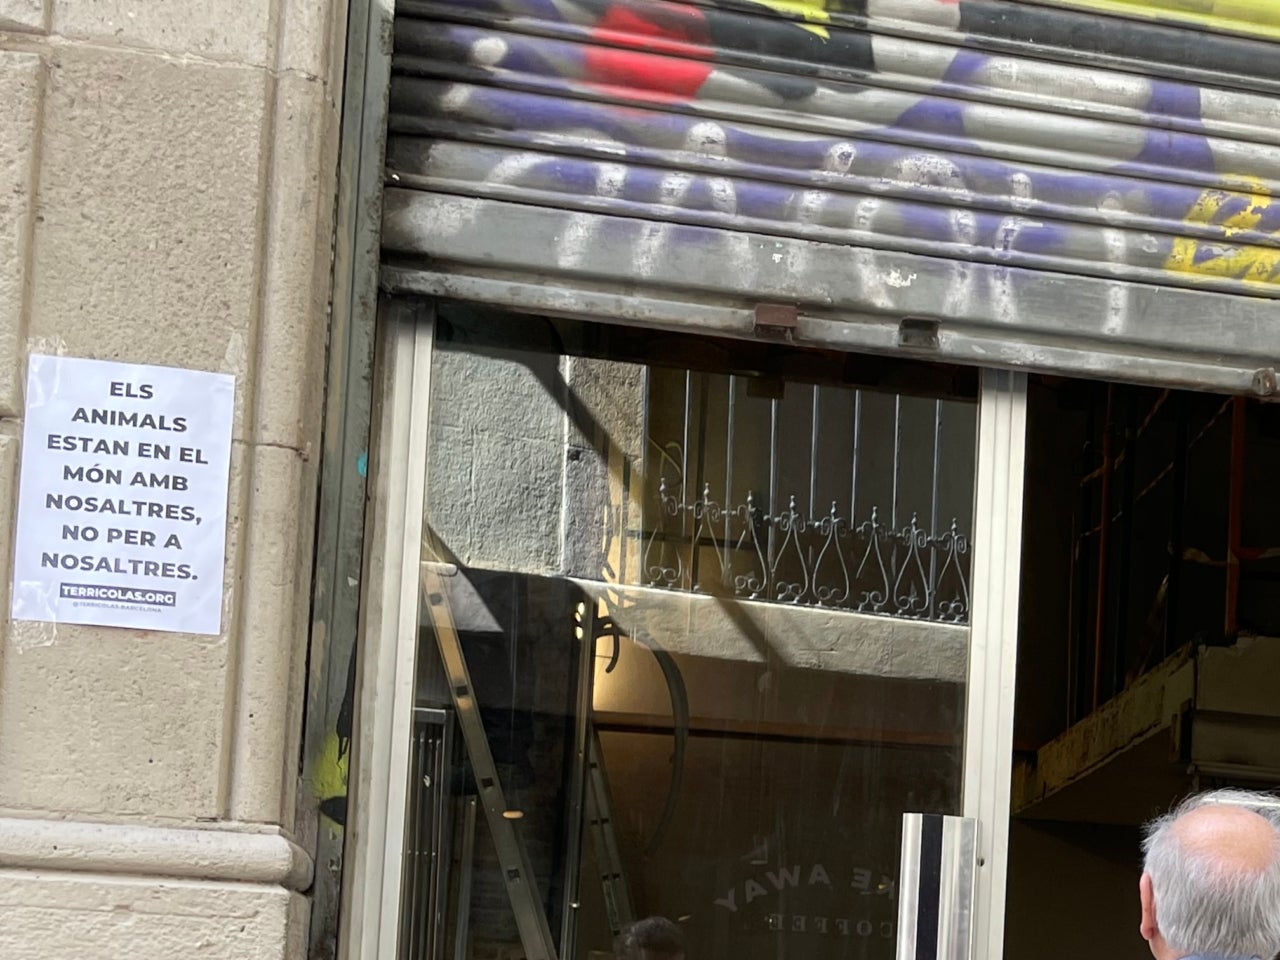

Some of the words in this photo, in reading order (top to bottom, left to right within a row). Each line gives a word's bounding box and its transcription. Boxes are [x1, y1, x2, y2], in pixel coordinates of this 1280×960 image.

[110, 381, 154, 399] ELS
[71, 406, 187, 432] ANIMALS
[47, 434, 129, 456] ESTAN
[137, 442, 170, 460] EN
[179, 447, 208, 464] EL
[63, 463, 122, 485] MÓN
[130, 471, 188, 491] AMB
[45, 493, 202, 525] NOSALTRES,
[62, 525, 99, 542] NO
[107, 528, 156, 547] PER
[163, 534, 182, 550] A
[41, 552, 198, 580] NOSALTRES.
[60, 584, 175, 604] TERRICOLAS.ORG
